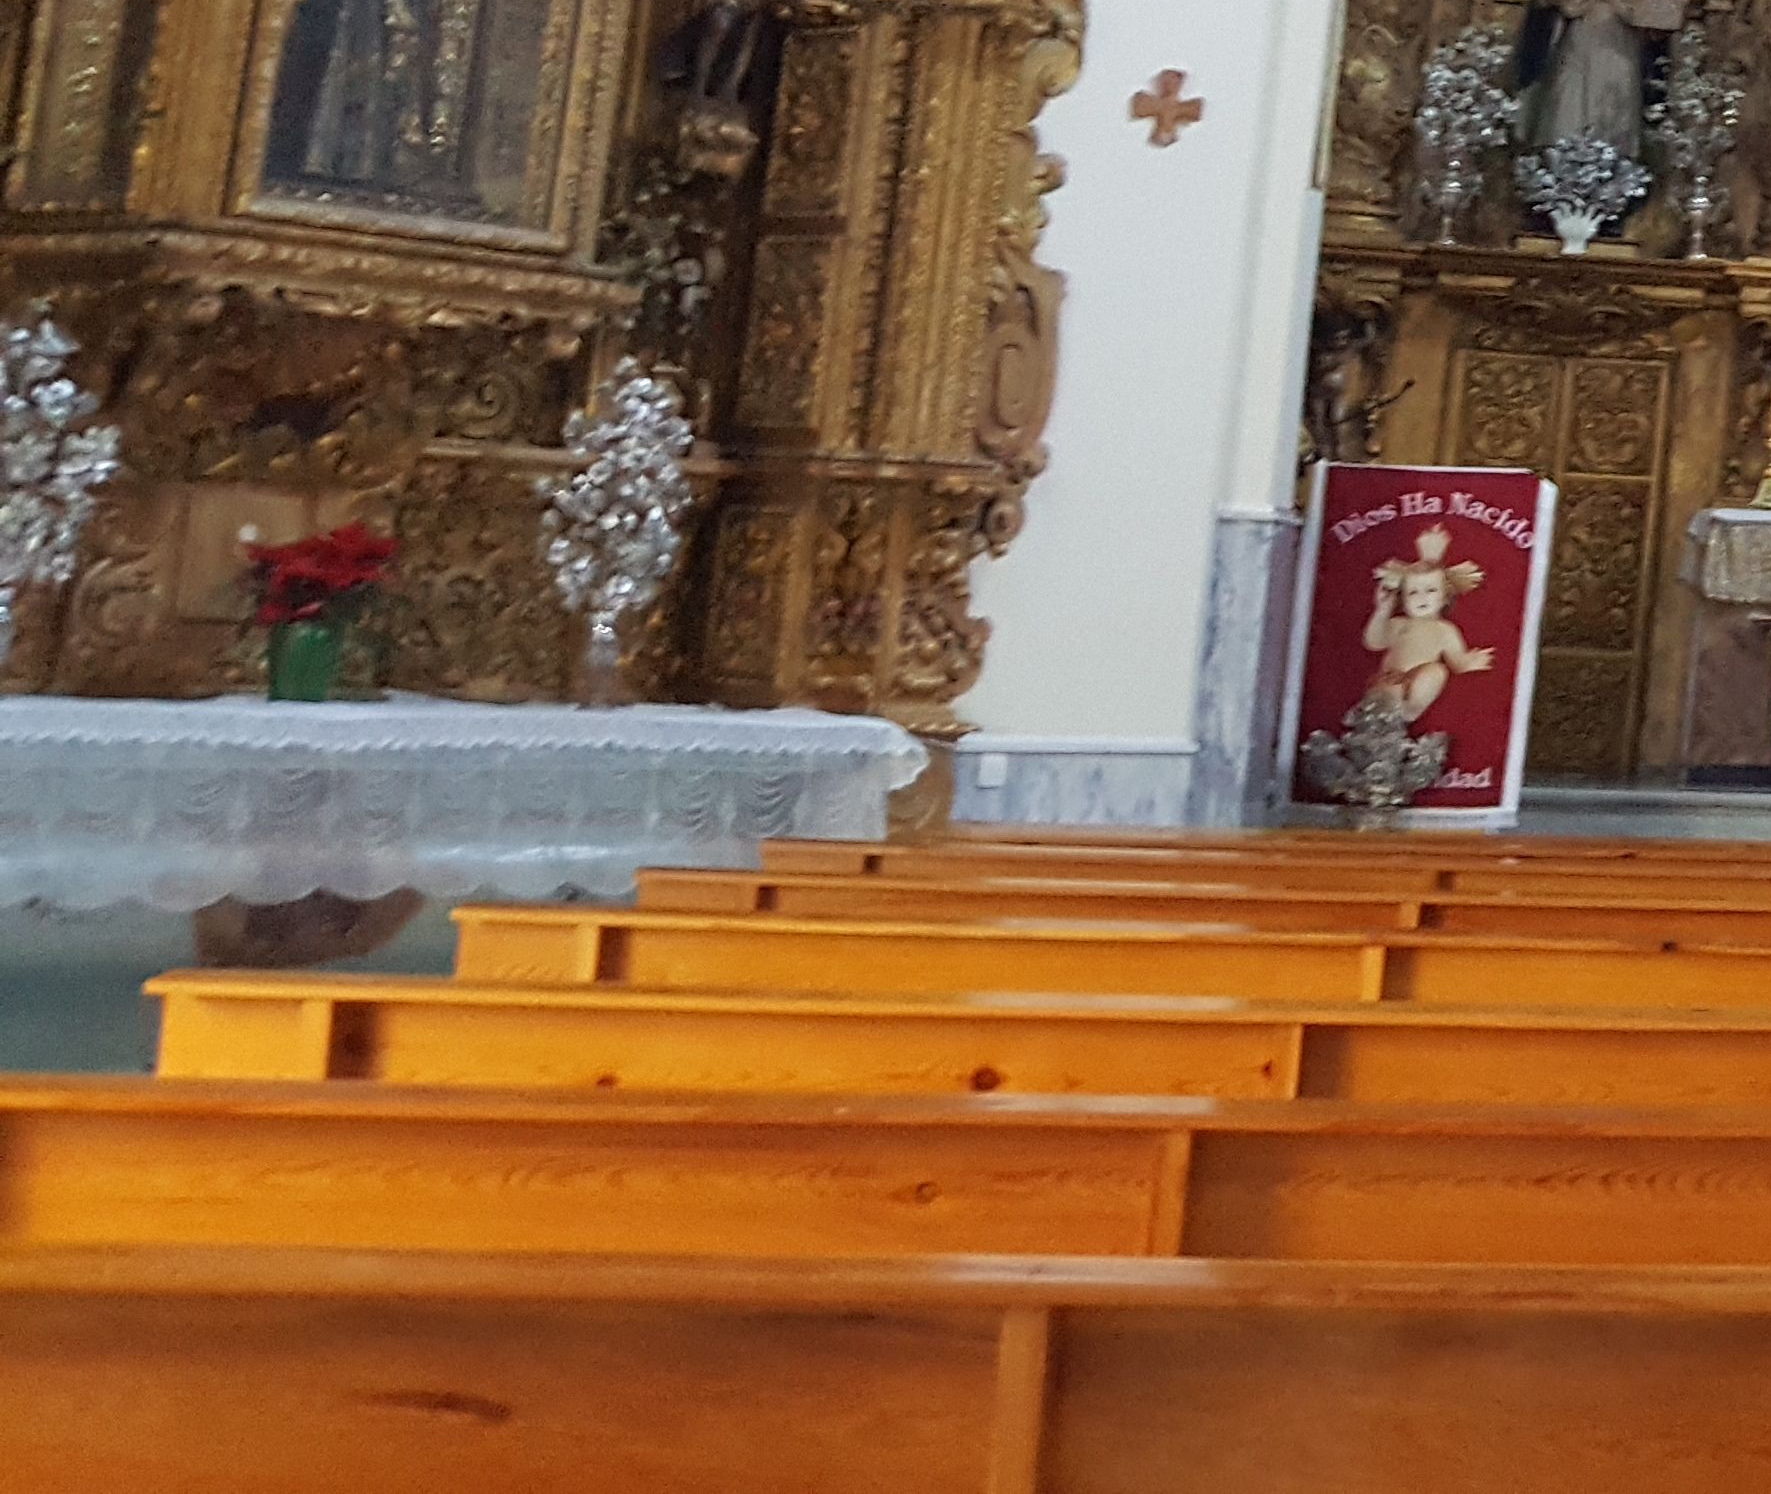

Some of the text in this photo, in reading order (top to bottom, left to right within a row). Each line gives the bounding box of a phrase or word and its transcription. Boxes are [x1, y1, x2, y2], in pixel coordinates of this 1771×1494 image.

[1330, 490, 1534, 549] Dios Ha Nacido
